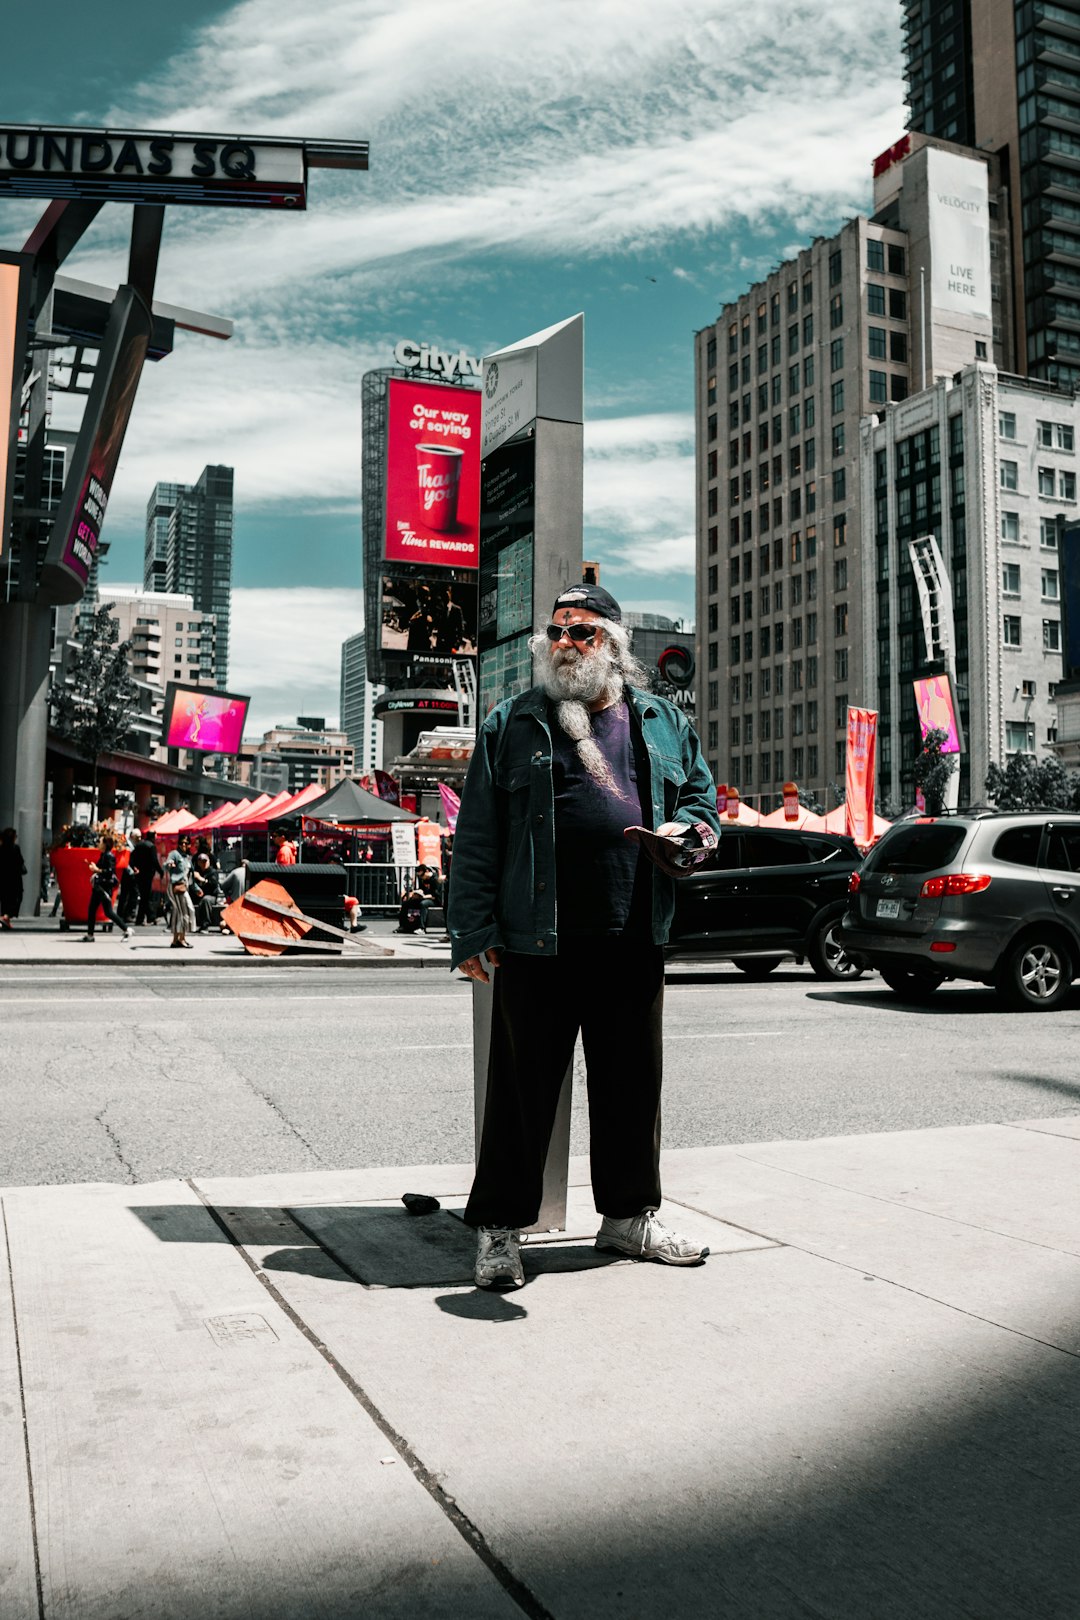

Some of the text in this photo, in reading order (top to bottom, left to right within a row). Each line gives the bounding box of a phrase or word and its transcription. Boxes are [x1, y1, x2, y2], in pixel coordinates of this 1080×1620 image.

[0, 134, 257, 181] UNDAS SQ
[936, 194, 980, 213] VELOCITY
[950, 264, 973, 280] LIVE
[948, 280, 976, 297] HERE
[394, 339, 483, 381] Citytv
[413, 404, 469, 426] Our way
[409, 418, 472, 439] of saying
[424, 489, 454, 511] you
[401, 530, 475, 553] Tims REWARDS
